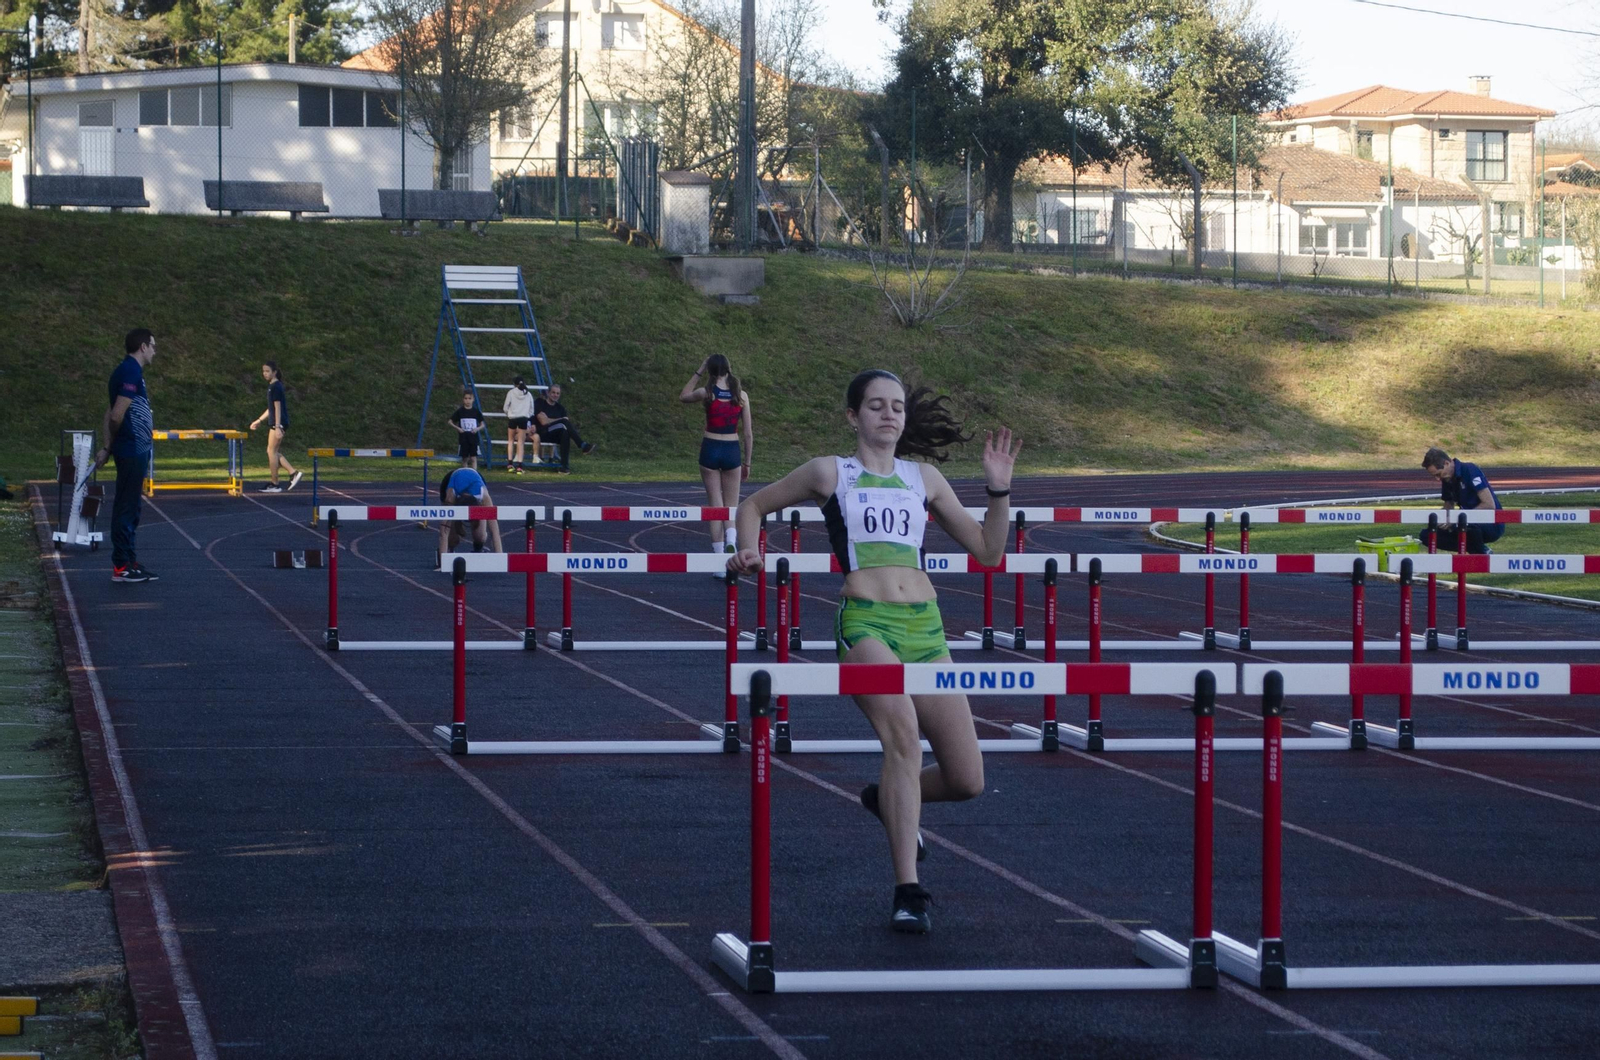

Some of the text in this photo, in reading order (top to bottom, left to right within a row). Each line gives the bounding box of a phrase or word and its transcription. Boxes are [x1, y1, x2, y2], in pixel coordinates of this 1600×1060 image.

[409, 509, 455, 518] MONDO
[643, 509, 688, 519] MONDO
[1094, 511, 1138, 520] MONDO
[1318, 512, 1361, 521] MONDO
[1534, 512, 1577, 521] MONDO
[863, 506, 911, 537] 603
[566, 557, 628, 570] MONDO
[1198, 558, 1259, 570] MONDO
[1508, 559, 1567, 571] MONDO
[935, 670, 1035, 690] MONDO
[1443, 670, 1541, 690] MONDO
[757, 748, 765, 783] MONDO
[1201, 747, 1209, 782] MONDO
[1269, 746, 1277, 781] MONDO
